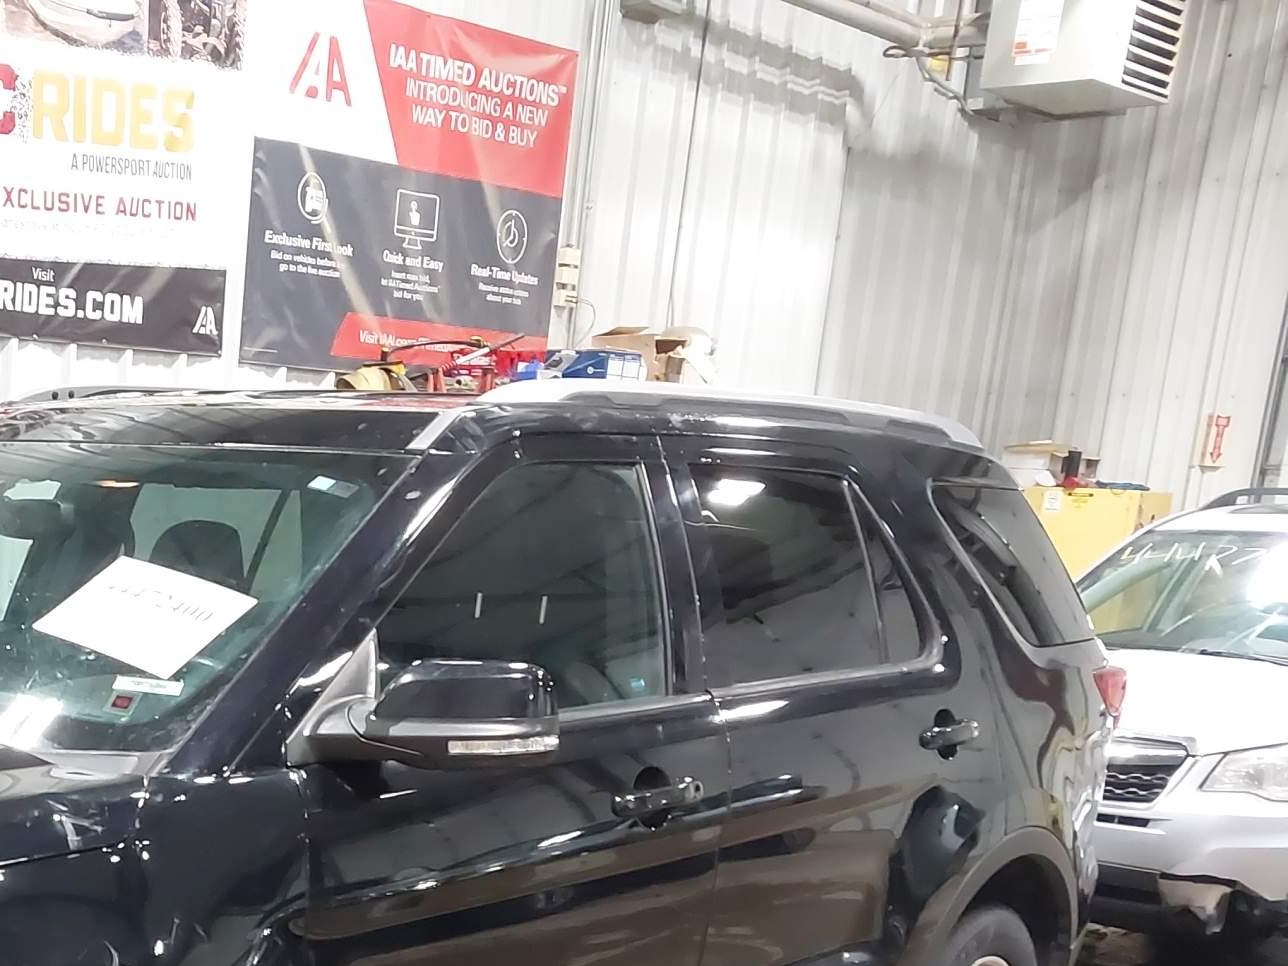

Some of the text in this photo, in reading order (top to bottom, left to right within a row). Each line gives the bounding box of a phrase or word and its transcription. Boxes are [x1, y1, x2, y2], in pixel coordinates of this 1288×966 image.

[388, 43, 417, 73] IAA
[419, 52, 476, 87] TIMED
[32, 68, 194, 153] RIDES
[405, 77, 549, 128] INTRODUCING A NEW
[412, 103, 537, 148] WAY TO BID & BUY
[70, 153, 192, 181] A POWERSPORT AUCTION
[115, 197, 197, 222] AUCTION
[264, 229, 312, 249] Exclusive
[382, 249, 444, 272] Quick and Easy
[32, 267, 56, 282] Visit
[470, 263, 539, 286] Real-Time Updates
[359, 329, 378, 344] Visit
